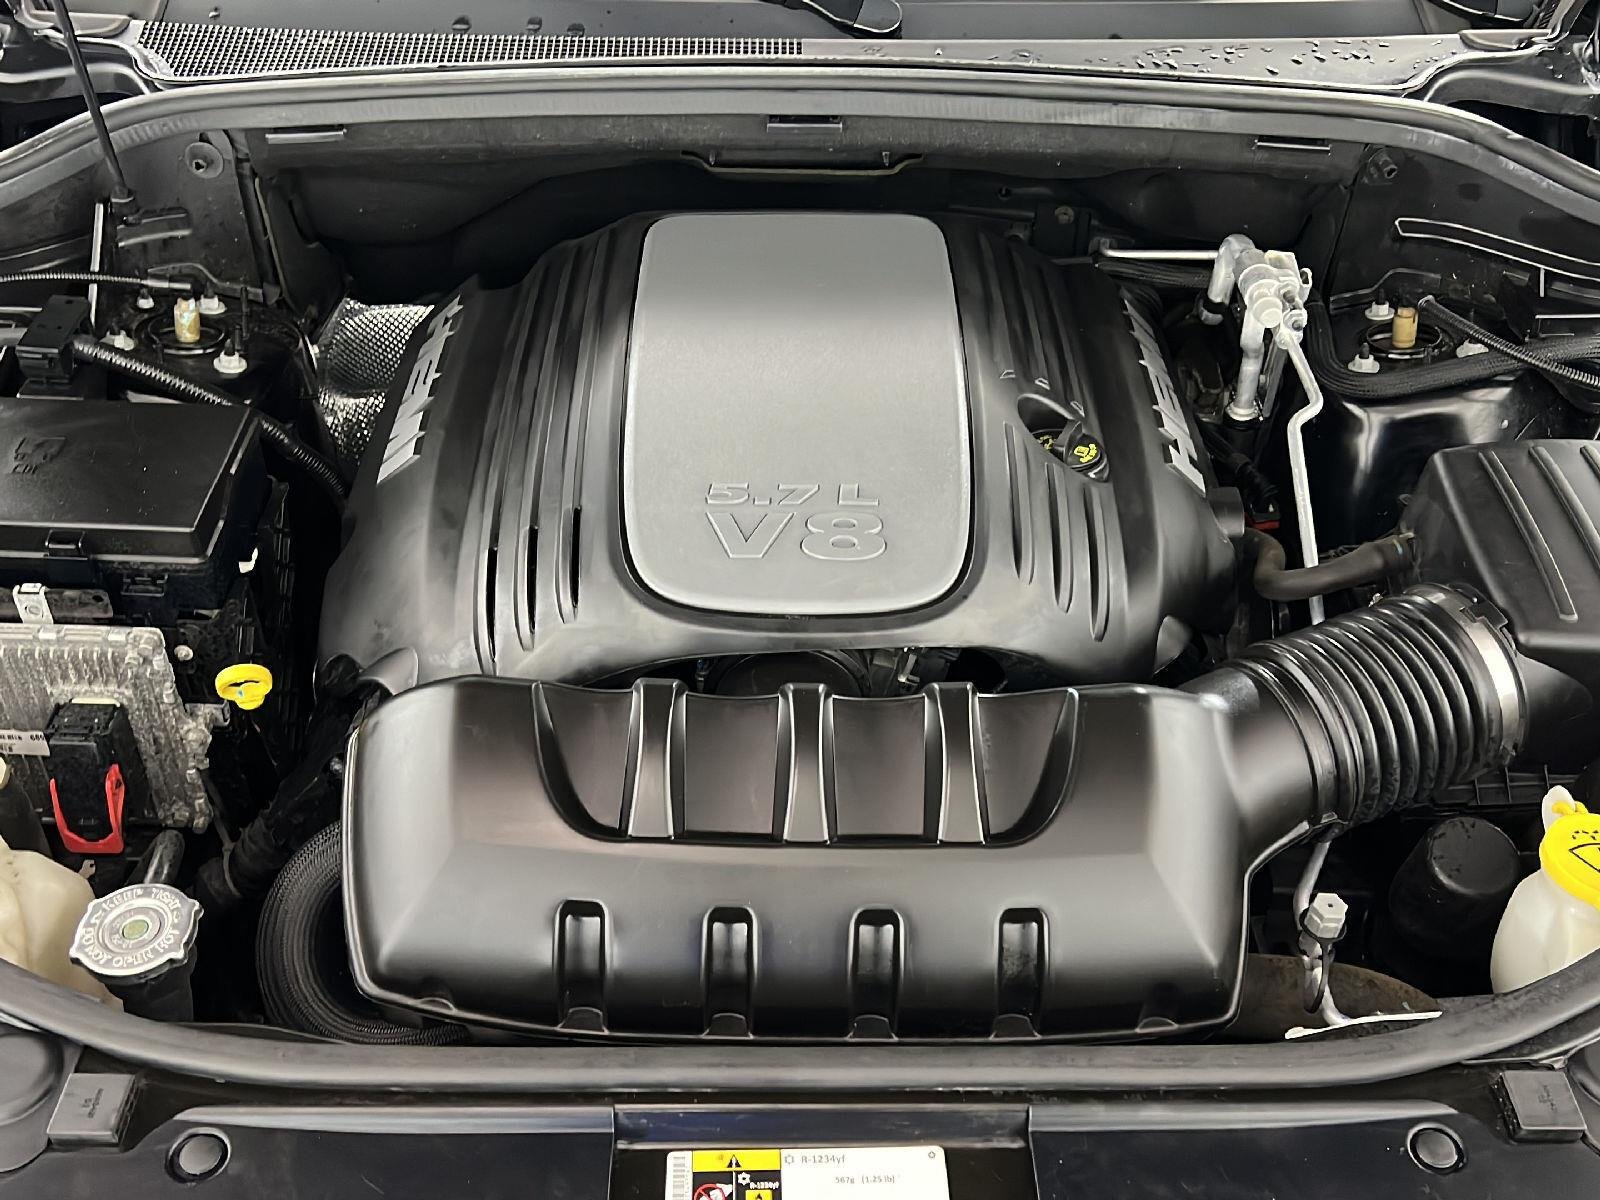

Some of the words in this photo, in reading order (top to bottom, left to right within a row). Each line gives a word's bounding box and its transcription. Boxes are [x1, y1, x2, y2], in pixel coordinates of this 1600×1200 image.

[706, 481, 820, 506] 5.7
[837, 482, 880, 506] L
[704, 511, 887, 561] V8
[102, 888, 145, 911] KEEP
[801, 1153, 846, 1166] R-1234yf
